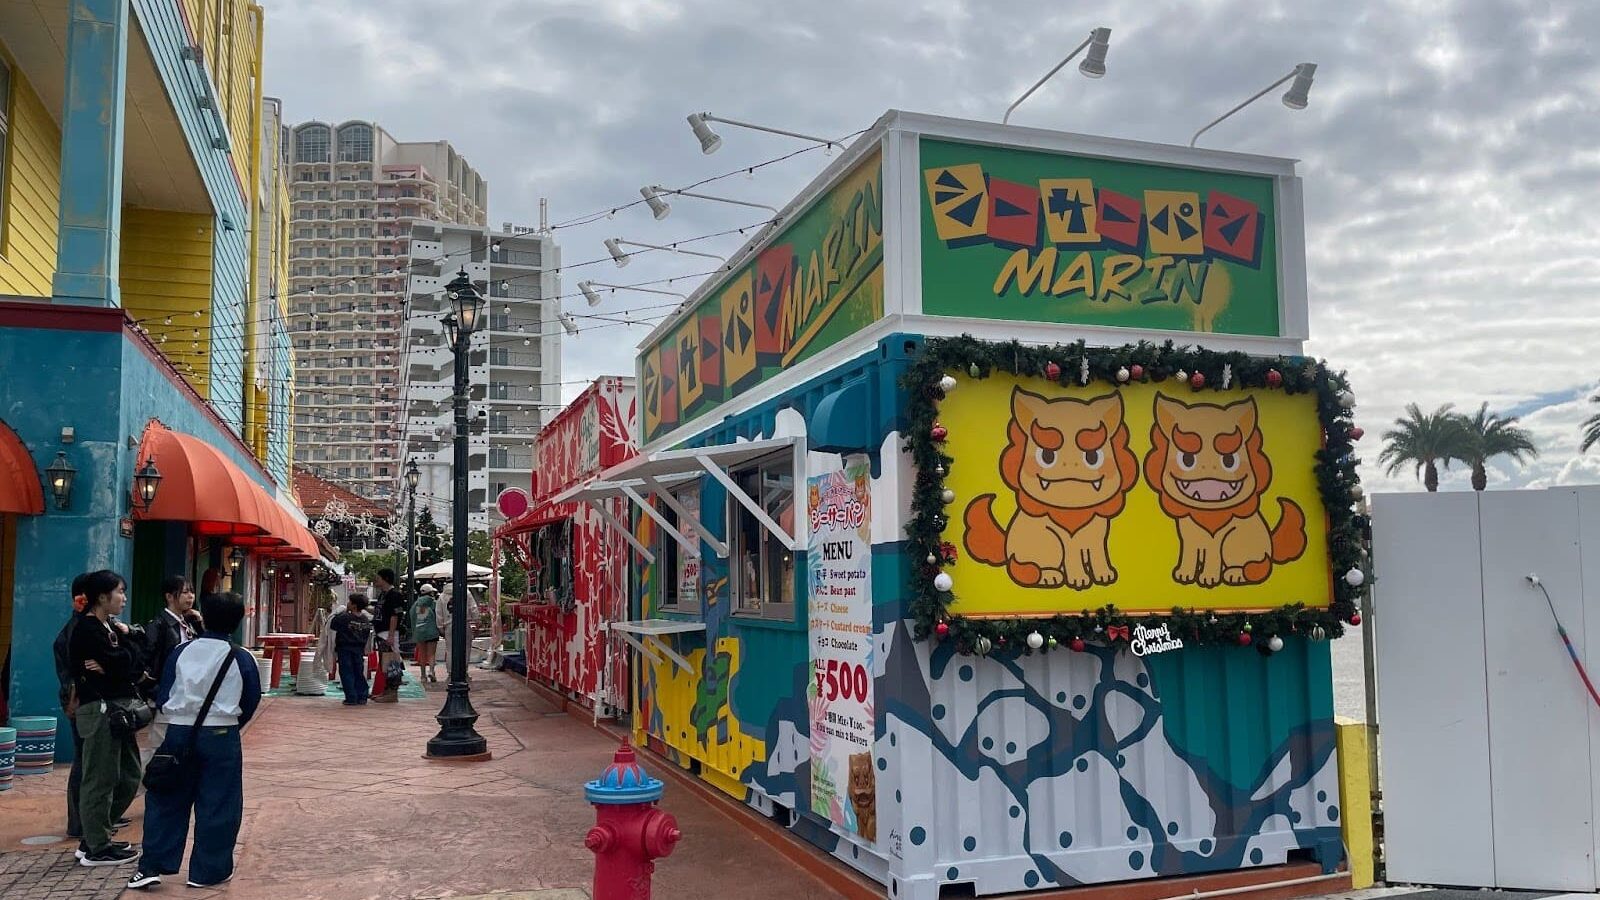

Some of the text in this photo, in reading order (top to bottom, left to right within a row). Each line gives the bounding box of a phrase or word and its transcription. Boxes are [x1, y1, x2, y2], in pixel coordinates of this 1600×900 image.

[930, 167, 1255, 253] シーサーパン
[779, 162, 882, 353] MARIN
[992, 247, 1213, 306] MARIN
[811, 498, 865, 533] シーサーパン
[822, 540, 853, 561] MENU
[830, 569, 846, 579] Sweet
[847, 570, 866, 581] potato
[830, 585, 843, 596] Bean
[831, 602, 849, 614] Cheese
[831, 620, 852, 632] Custard
[1133, 622, 1171, 641] Merry
[831, 637, 858, 651] Chocolate
[1130, 637, 1184, 657] Christmas
[813, 658, 826, 670] ALL
[815, 721, 826, 733] You
[845, 731, 849, 741] 2
